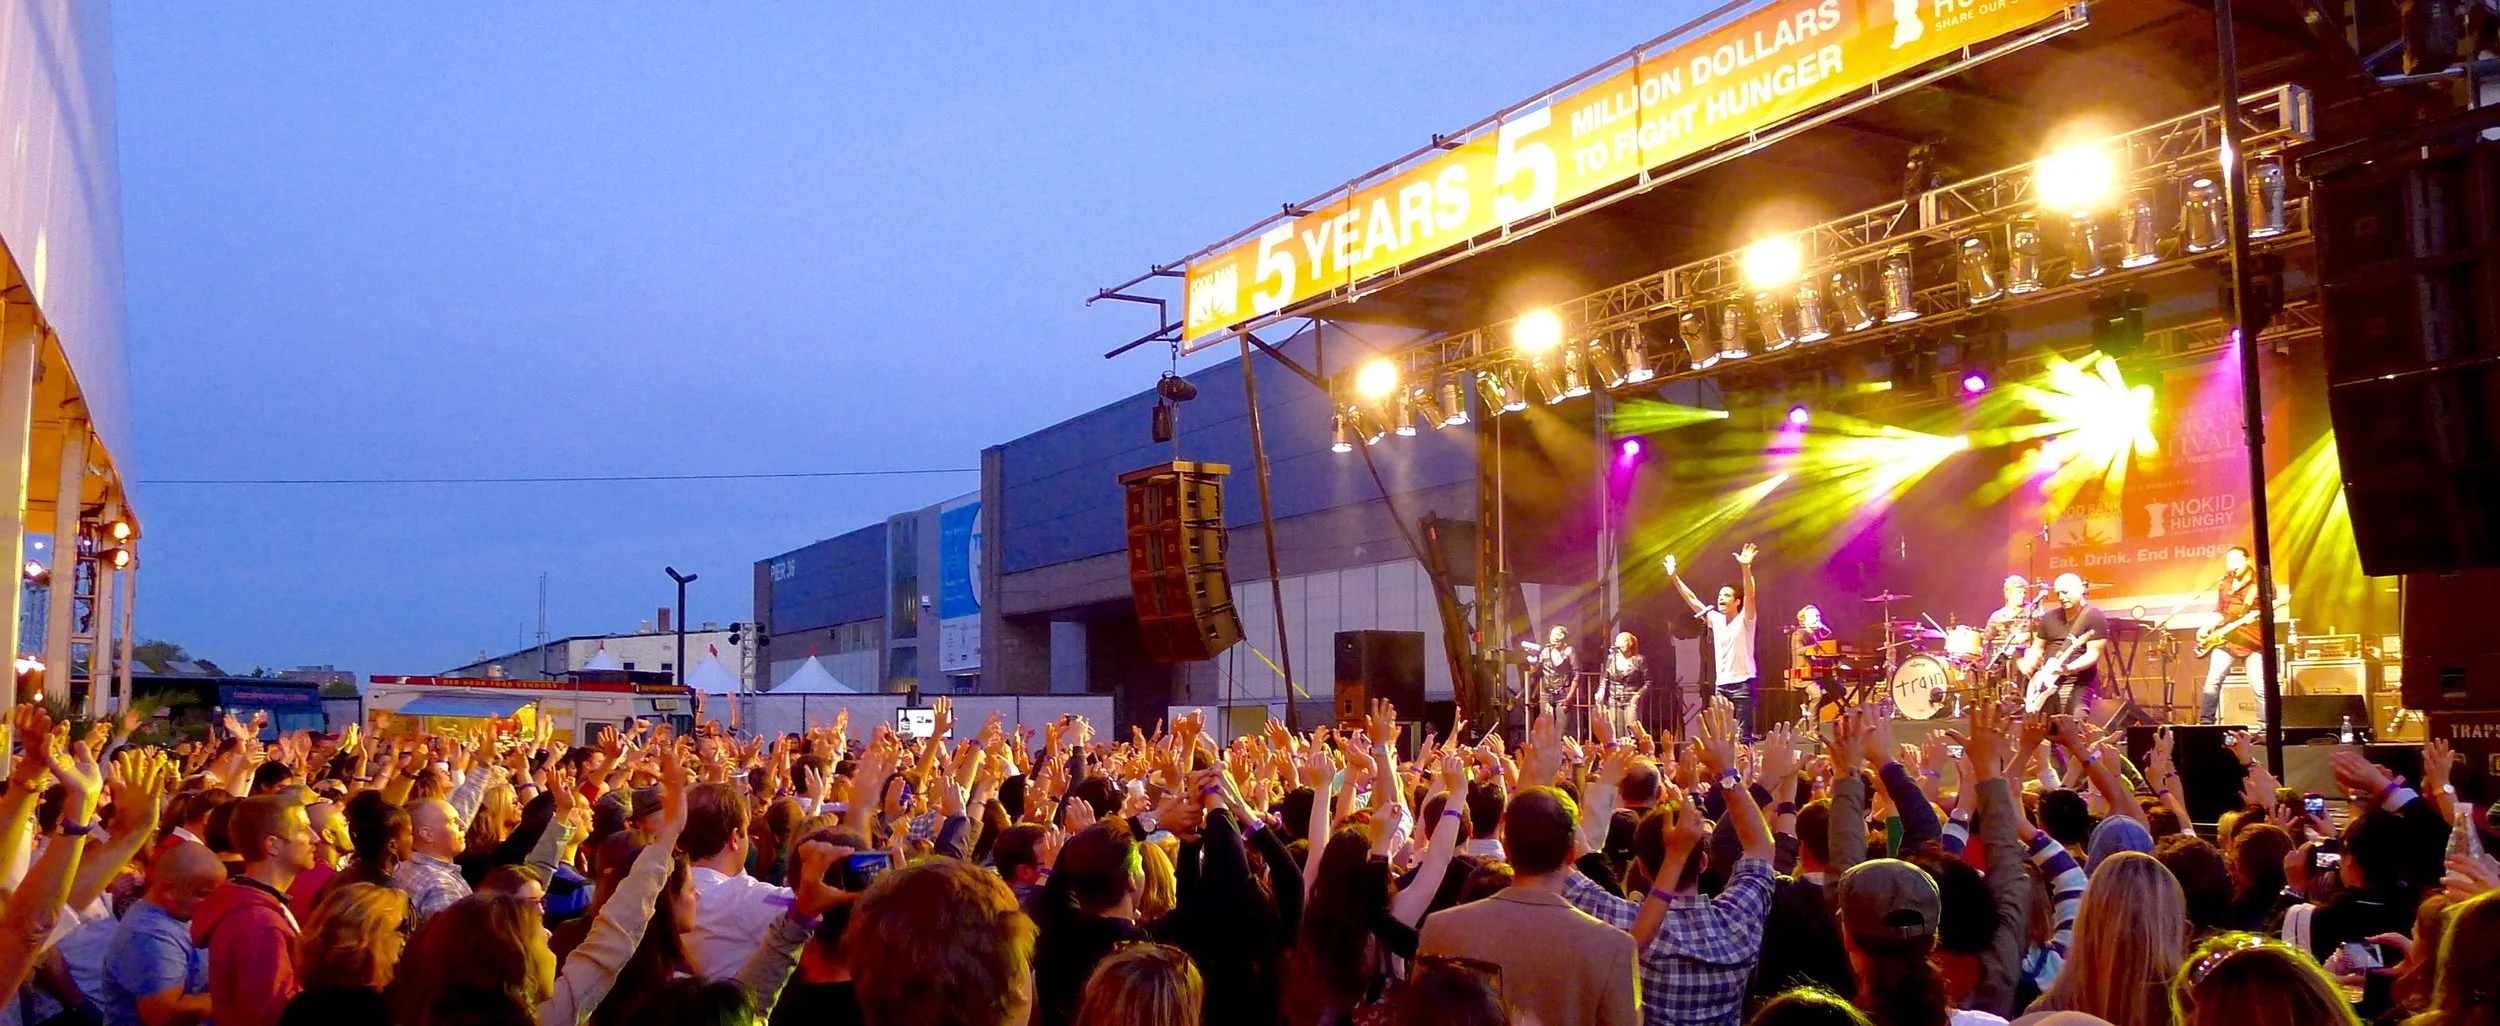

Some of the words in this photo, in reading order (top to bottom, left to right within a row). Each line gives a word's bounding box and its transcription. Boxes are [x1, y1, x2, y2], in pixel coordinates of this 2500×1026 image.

[1935, 10, 1974, 31] SHARE
[1978, 0, 2006, 15] OUR
[1571, 67, 1681, 140] MILLION
[1690, 0, 1841, 88] DOLLARS
[1572, 141, 1608, 177] TO
[1614, 103, 1698, 162] FIGHT
[1706, 44, 1843, 125] HUNGER
[1251, 221, 1295, 317] 5
[1301, 164, 1471, 280] YEARS
[1492, 106, 1557, 225] 5
[2171, 511, 2234, 530] HUNGRY
[2050, 556, 2078, 568] Eat.
[2085, 552, 2131, 566] Drink.
[2137, 547, 2168, 561] End
[771, 562, 786, 581] PIER
[516, 681, 557, 690] VENDORS
[1895, 673, 1943, 697] train
